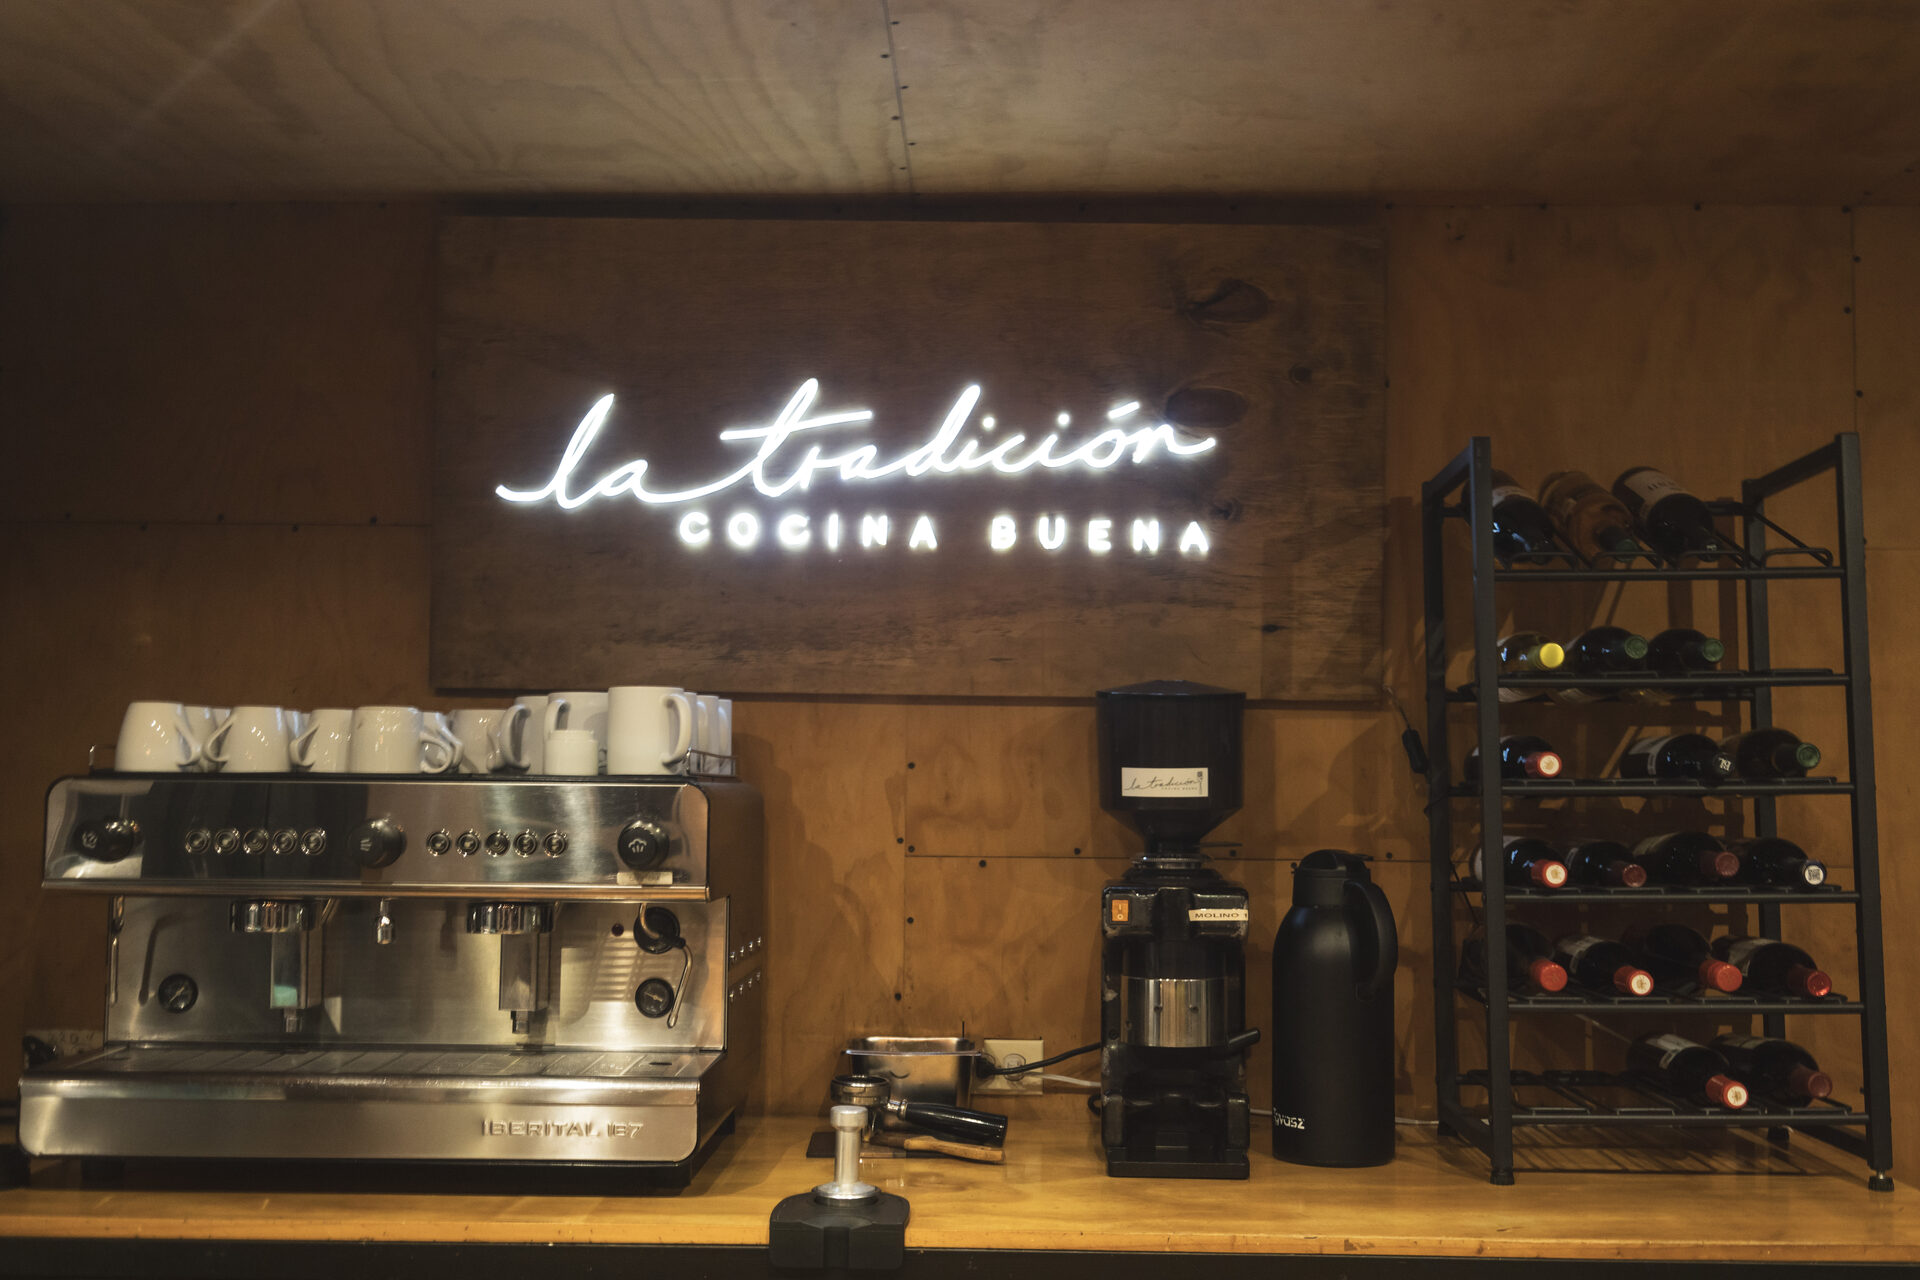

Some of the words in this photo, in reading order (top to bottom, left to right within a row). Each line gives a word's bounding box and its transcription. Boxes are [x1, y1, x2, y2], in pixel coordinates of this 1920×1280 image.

[496, 394, 668, 508] la
[712, 378, 1217, 497] tradición
[679, 511, 938, 549] COCINA
[991, 516, 1209, 552] BUENA
[481, 1119, 600, 1138] IBERITAL
